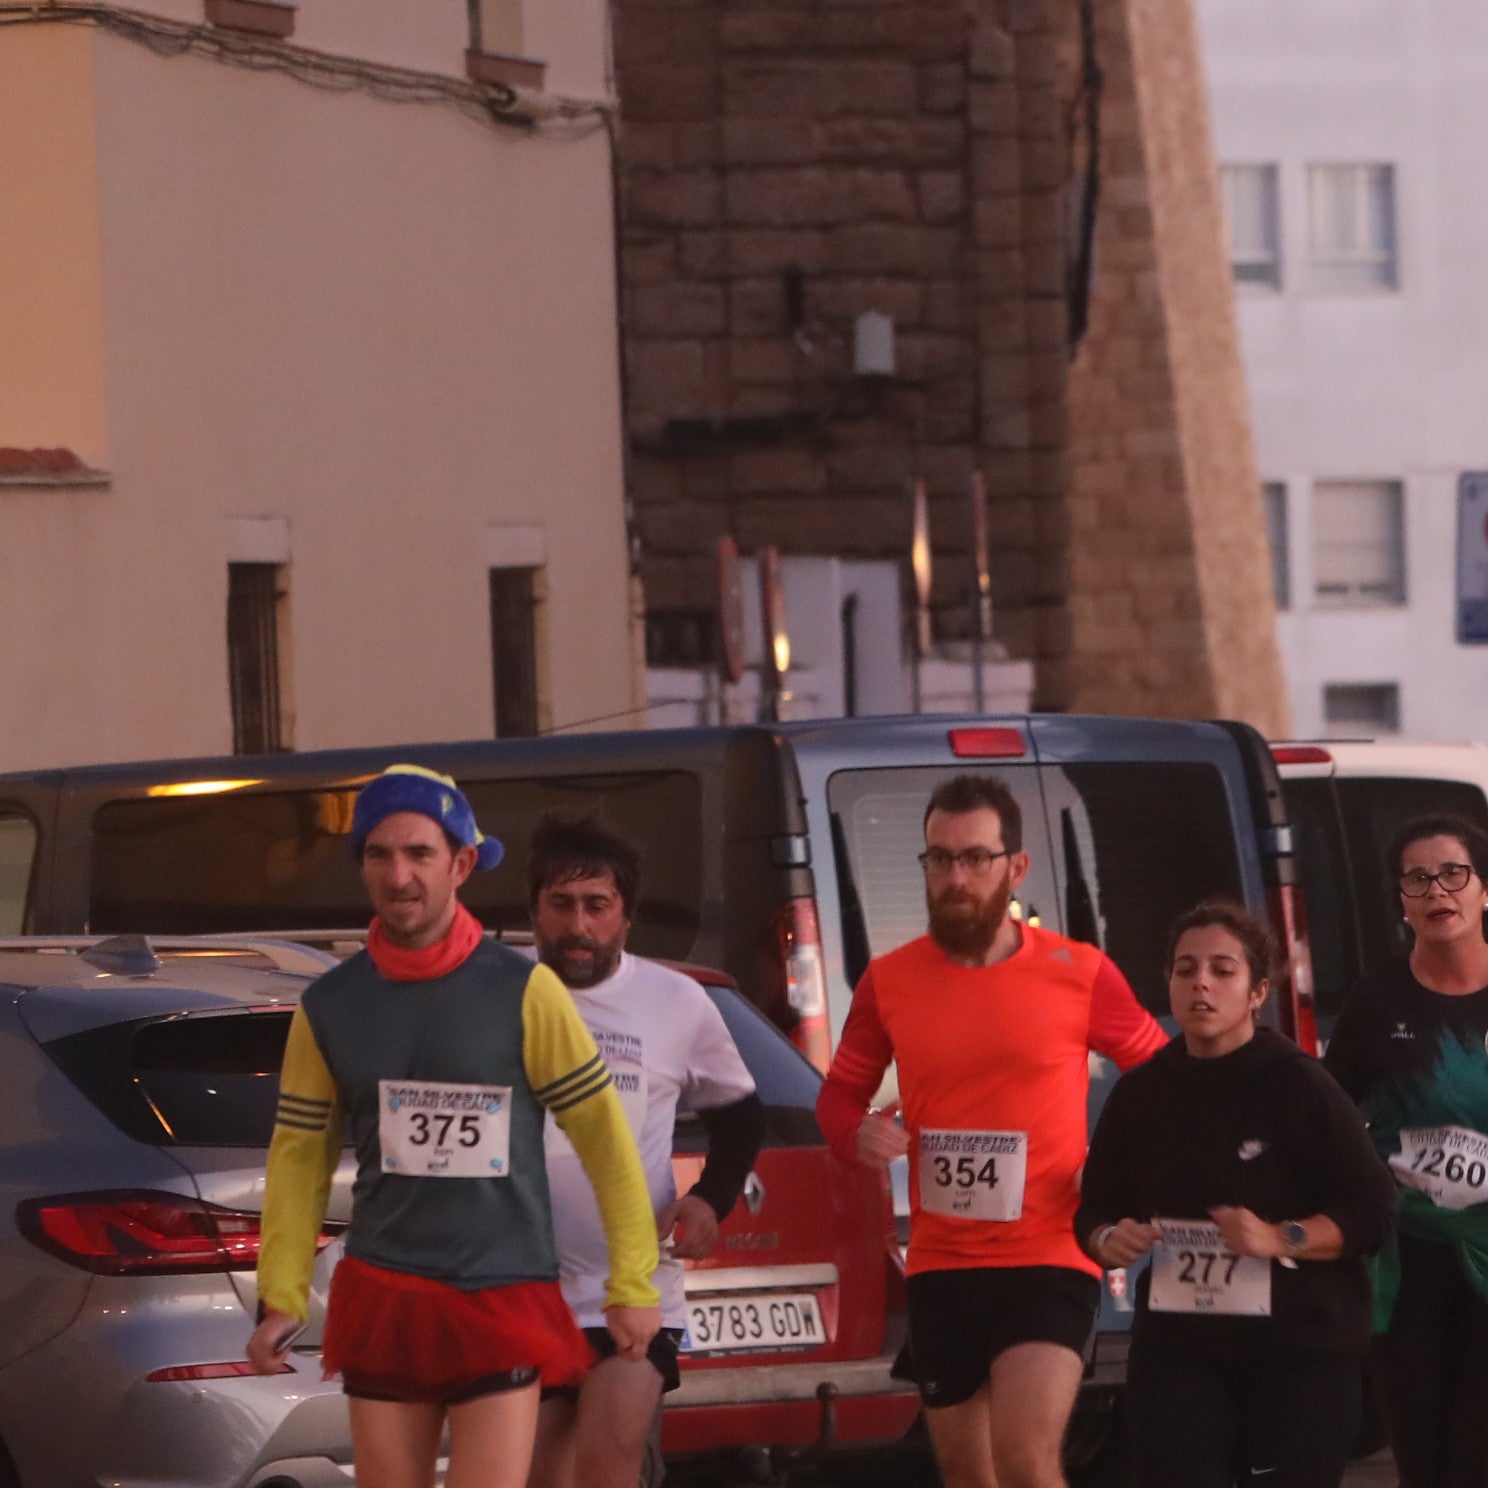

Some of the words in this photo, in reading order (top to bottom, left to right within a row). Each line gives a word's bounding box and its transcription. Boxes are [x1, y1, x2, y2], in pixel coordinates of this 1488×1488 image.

[409, 1113, 481, 1148] 375
[934, 1156, 998, 1190] 354
[1411, 1147, 1486, 1189] 1260
[1179, 1251, 1241, 1284] 277
[692, 1303, 763, 1343] 3783
